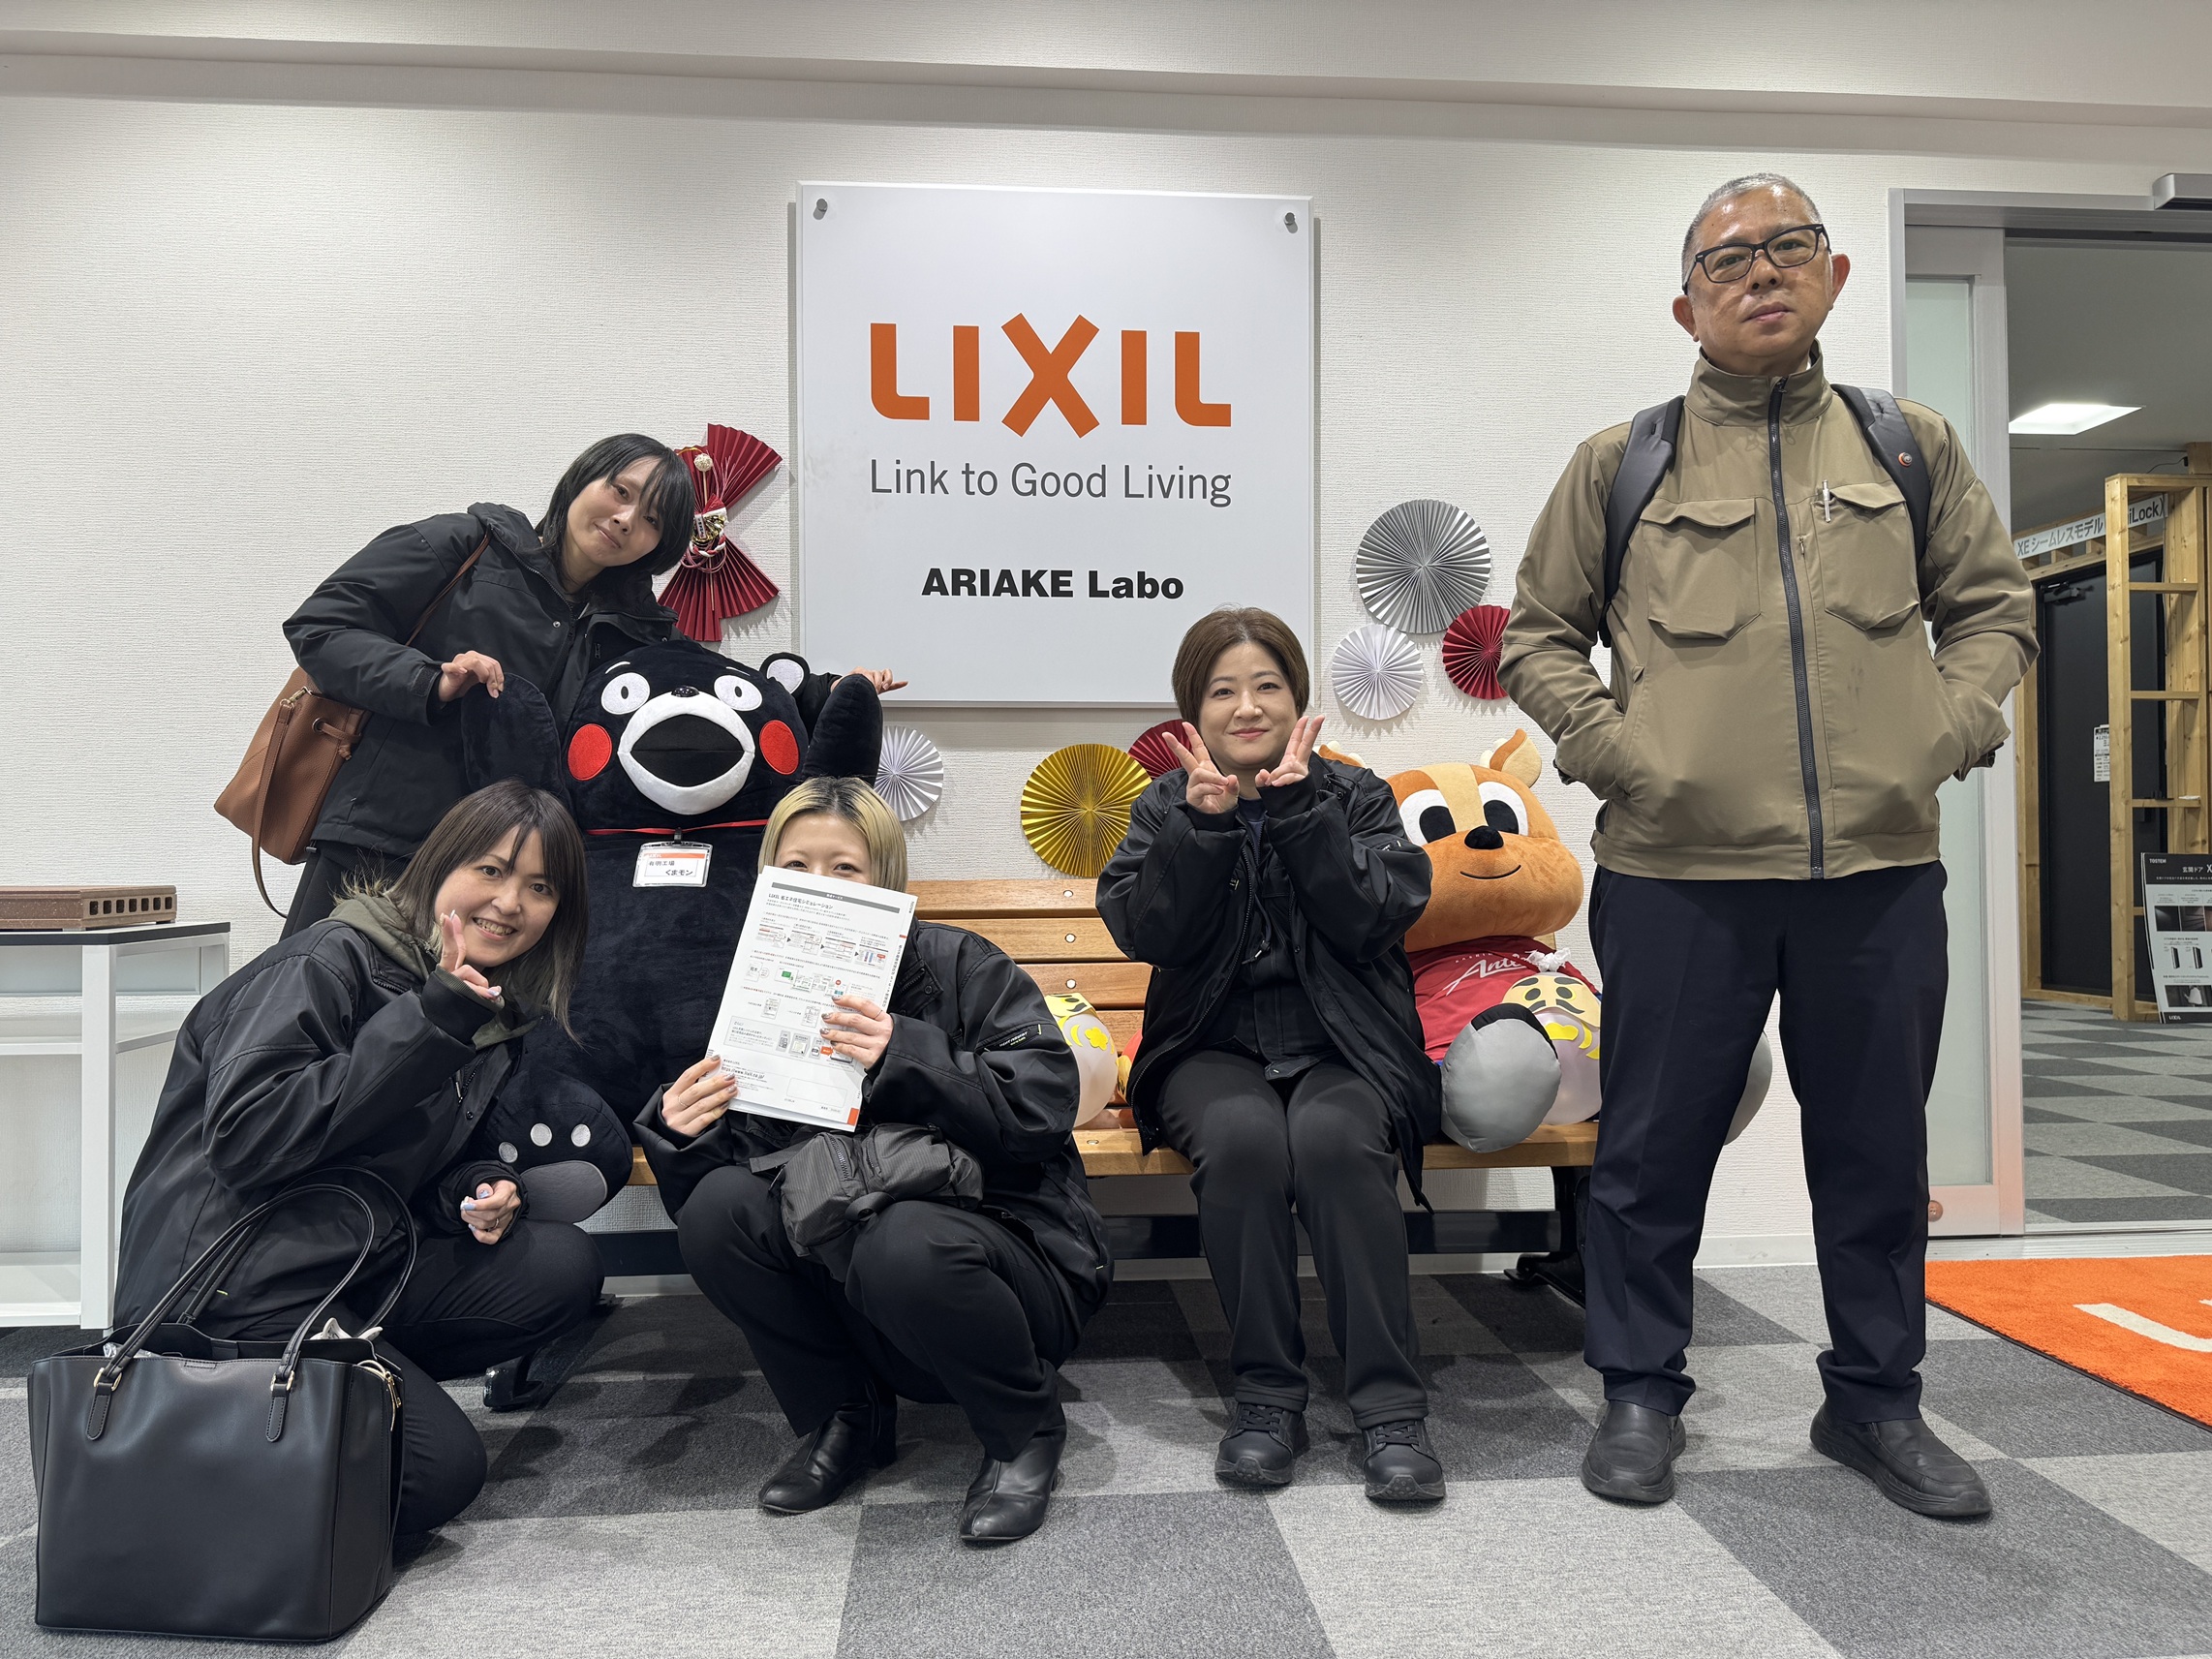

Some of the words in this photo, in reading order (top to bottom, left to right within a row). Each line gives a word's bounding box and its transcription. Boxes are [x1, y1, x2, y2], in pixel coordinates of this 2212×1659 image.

[871, 313, 1232, 438] LIXIL
[871, 459, 950, 495] Link
[962, 462, 998, 496] to
[1011, 462, 1107, 499] Good
[1124, 464, 1232, 507] Living
[2128, 498, 2165, 525] iLock)
[2017, 539, 2030, 557] XE
[2031, 516, 2104, 553] シームレスモデル
[921, 568, 1074, 599] ARIAKE
[1088, 569, 1184, 599] Labo
